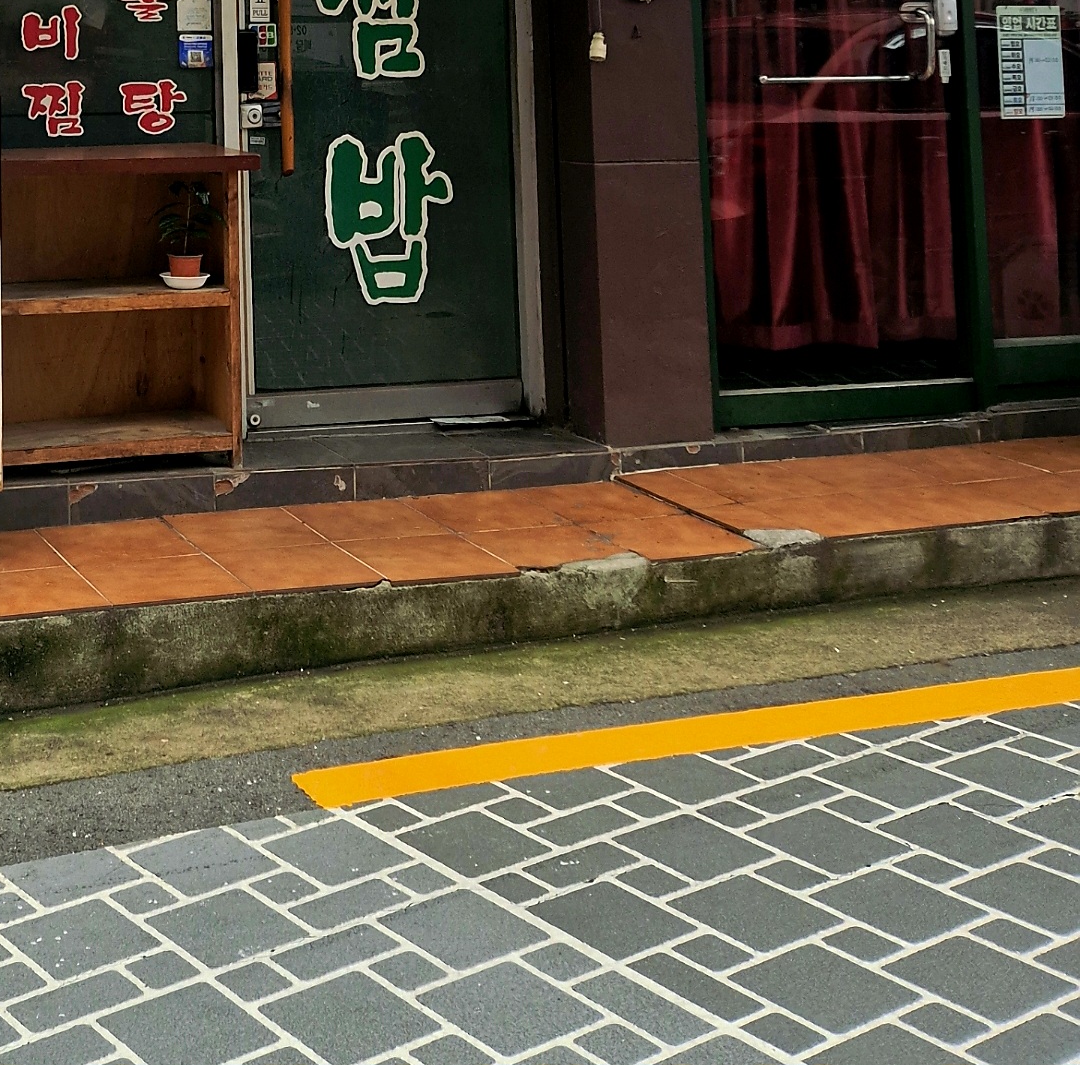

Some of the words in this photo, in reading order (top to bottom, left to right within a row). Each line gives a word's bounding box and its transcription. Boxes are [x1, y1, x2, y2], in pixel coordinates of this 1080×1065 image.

[1001, 16, 1022, 31] 영업
[1025, 16, 1057, 31] 시간표
[258, 31, 274, 39] CB
